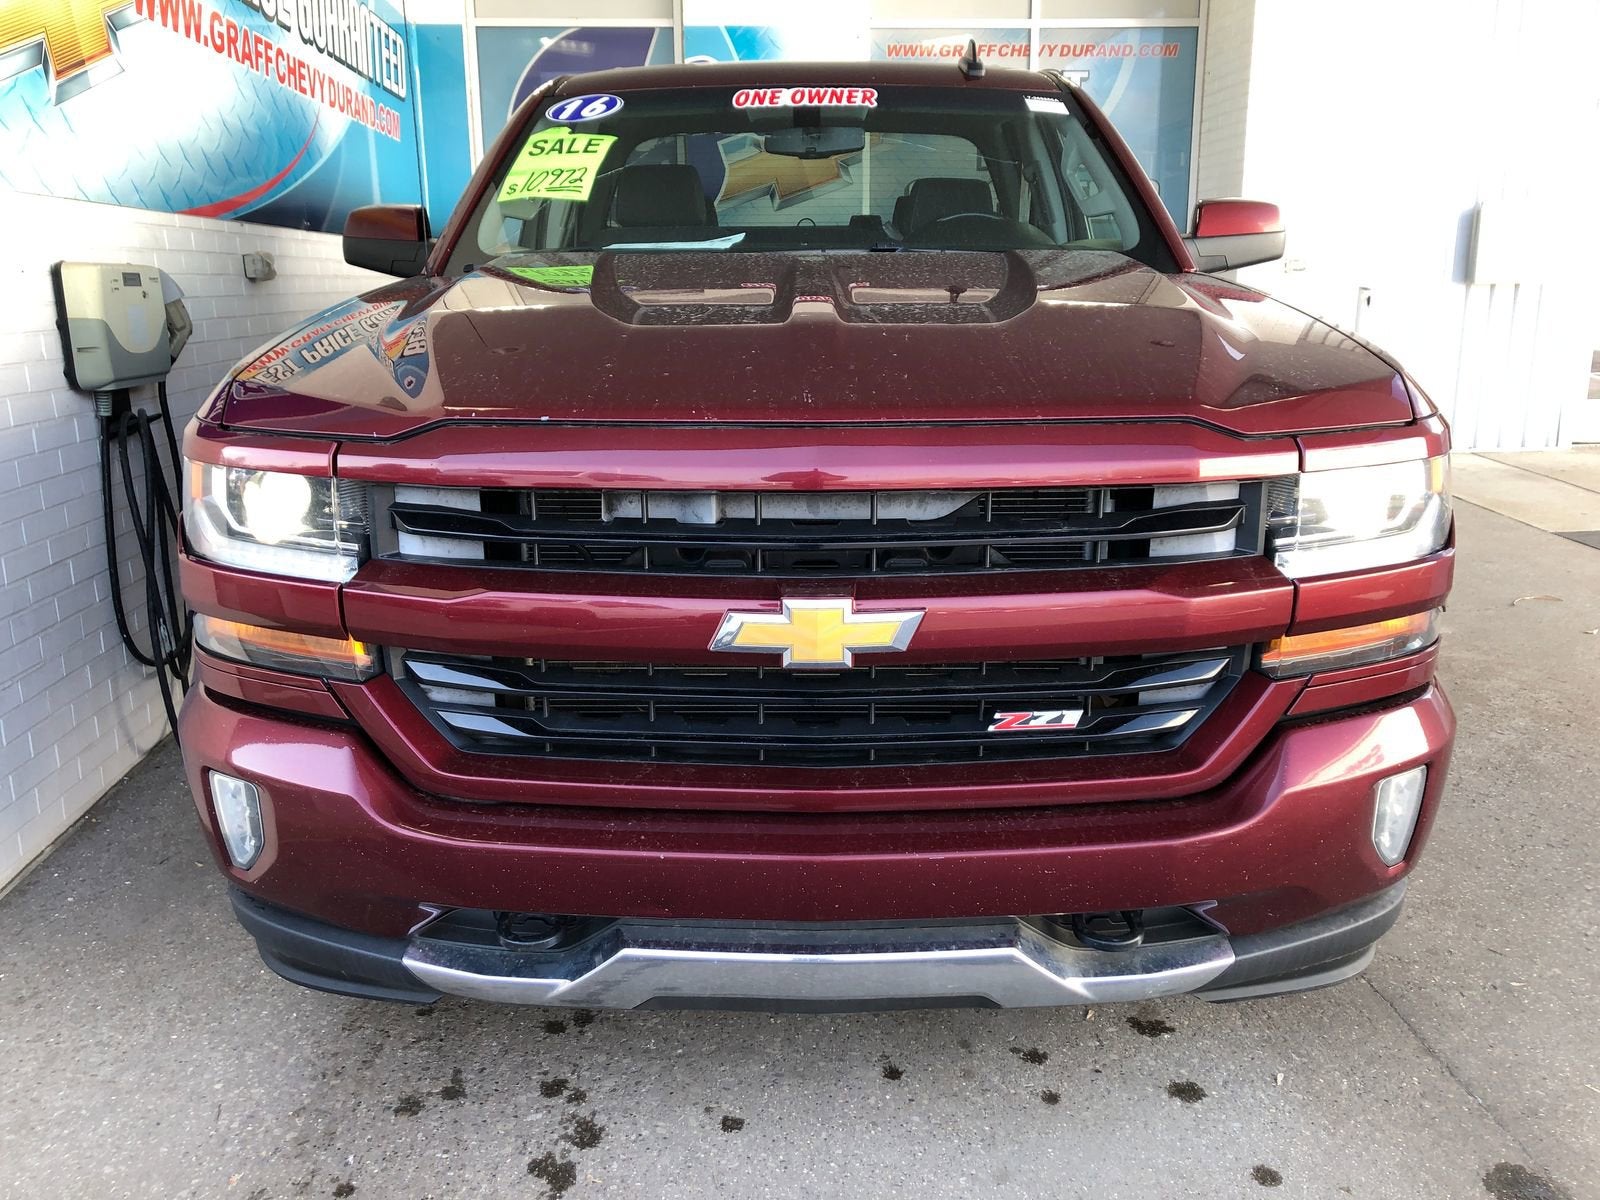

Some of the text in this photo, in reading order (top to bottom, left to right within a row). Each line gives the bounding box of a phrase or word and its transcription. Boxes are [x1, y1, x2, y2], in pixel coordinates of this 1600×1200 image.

[887, 43, 1178, 57] WWW.GRFFCHEYDURAND.COM
[735, 89, 877, 106] ONE OWNER
[558, 97, 610, 119] 16
[528, 138, 604, 156] SALE
[987, 710, 1084, 731] Z71
